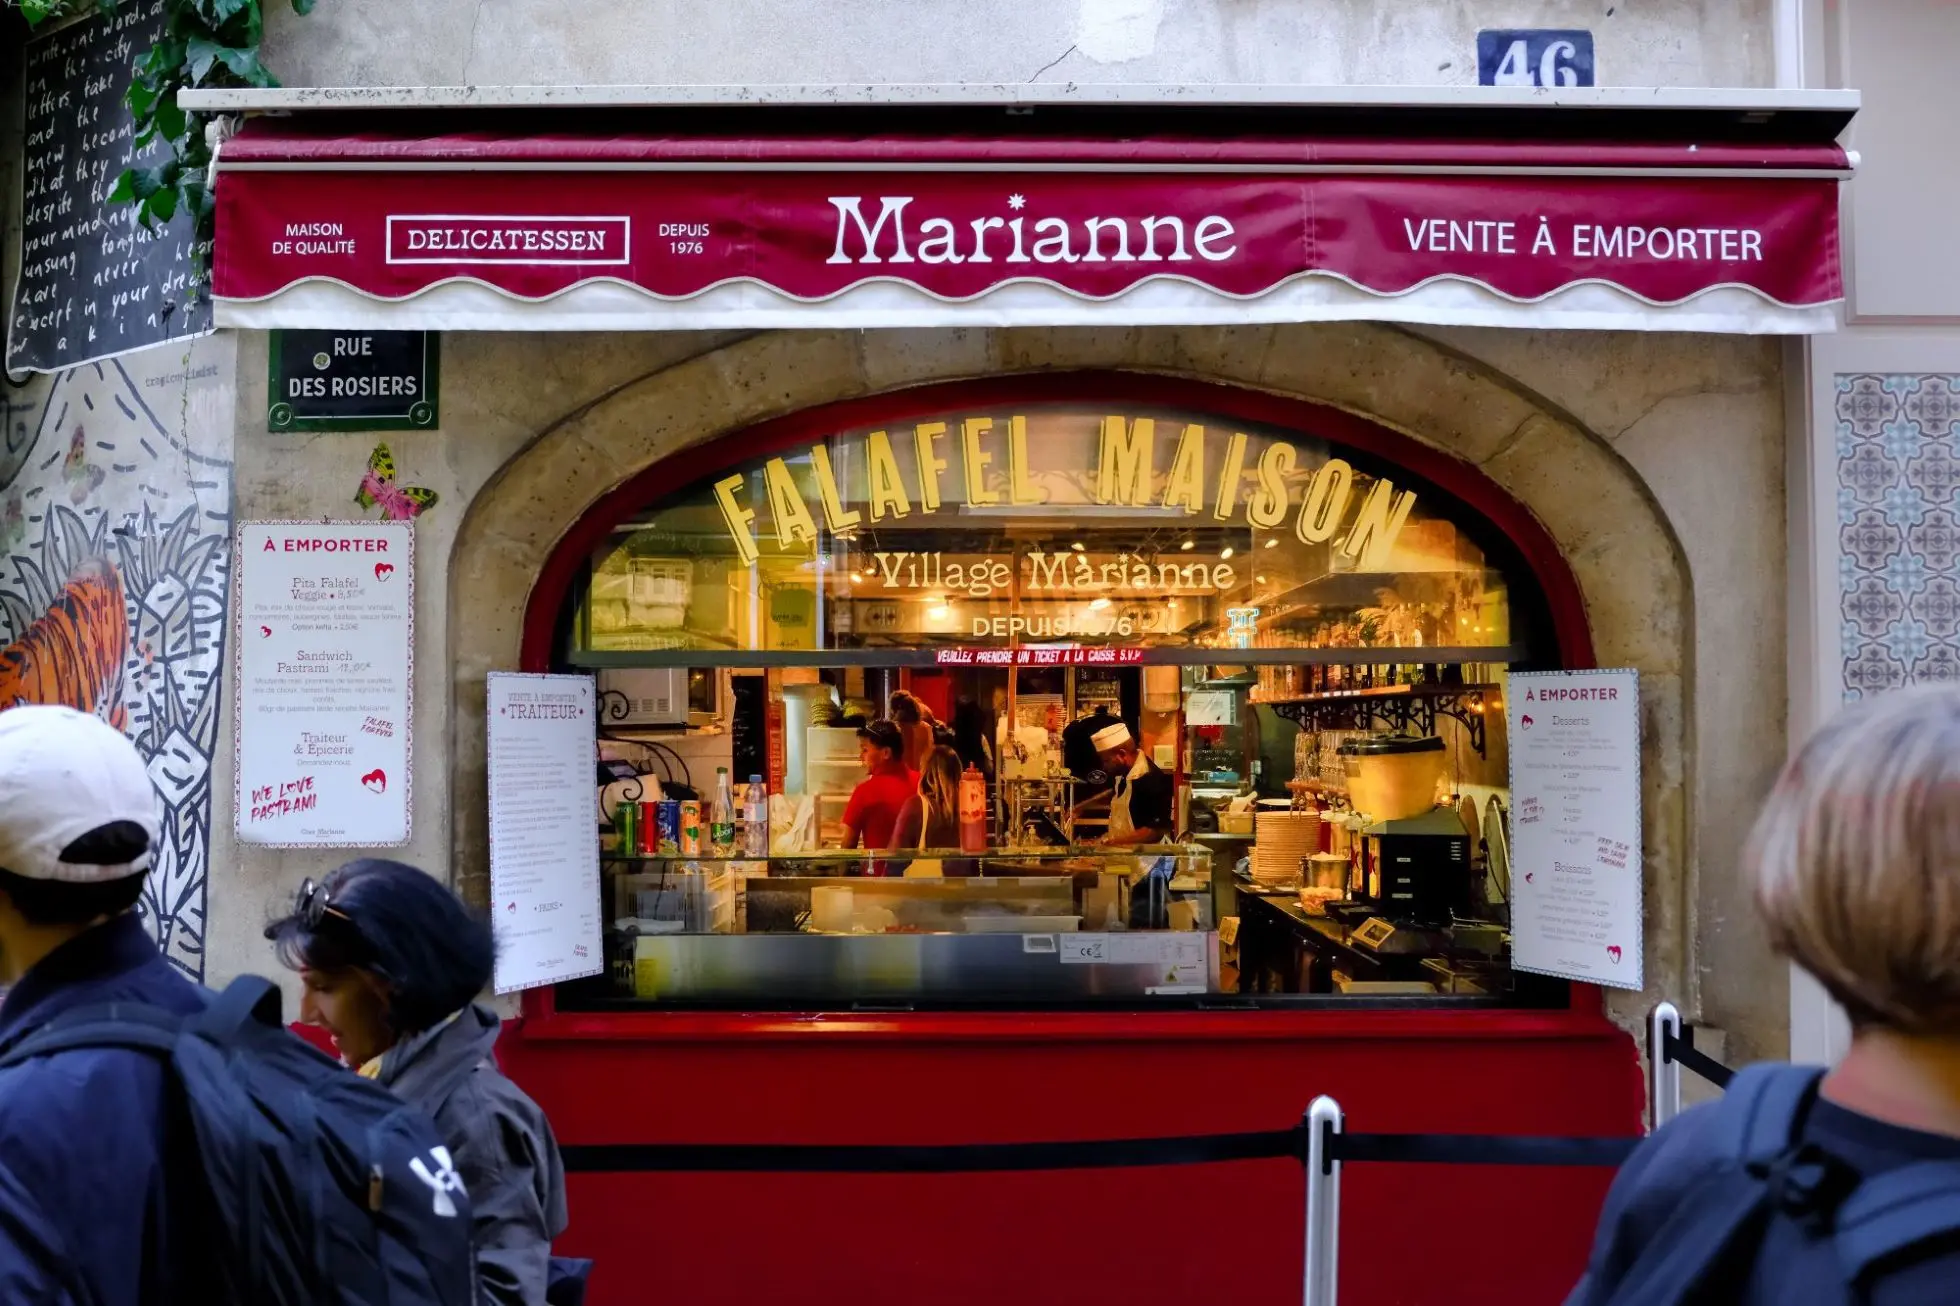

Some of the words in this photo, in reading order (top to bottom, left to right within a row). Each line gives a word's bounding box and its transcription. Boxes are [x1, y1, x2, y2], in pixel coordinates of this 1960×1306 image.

[1493, 40, 1577, 87] 46
[27, 118, 55, 146] and
[77, 105, 99, 128] the
[76, 158, 109, 184] they
[25, 190, 73, 227] despite
[25, 233, 56, 260] your
[62, 207, 101, 242] mind
[285, 222, 343, 238] MAISON
[658, 222, 710, 238] DEPUIS
[825, 192, 1237, 265] Marianne
[1403, 217, 1516, 255] VENTE
[1532, 215, 1557, 256] À
[1573, 225, 1763, 262] EMPORTER
[272, 241, 291, 255] DE
[295, 238, 356, 257] QUALITÉ
[407, 228, 607, 252] DELICATESSEN
[669, 241, 703, 255] 1976
[24, 251, 76, 279] unsung
[93, 258, 140, 287] never
[84, 297, 97, 316] in
[112, 284, 150, 317] your
[333, 336, 373, 357] RUE
[288, 377, 326, 398] DES
[330, 375, 418, 397] ROSIERS
[712, 414, 1050, 569] FALAFEL
[1099, 415, 1418, 572] MAISON
[263, 535, 276, 552] À
[284, 539, 389, 552] EMPORTER
[293, 577, 317, 589] Pita
[320, 576, 359, 589] Falafel
[873, 550, 1012, 597] Village
[1028, 550, 1236, 590] Marianne
[291, 589, 328, 602] Veggie
[972, 616, 1069, 638] DEPUIS
[296, 650, 353, 661] Sandwich
[976, 649, 1013, 663] PRENDRE
[1017, 649, 1030, 663] UN
[1034, 649, 1060, 663] TICKET
[1074, 649, 1084, 662] LA
[1087, 649, 1116, 662] CAISSE
[277, 662, 330, 674] Pastrami
[1526, 686, 1535, 701] À
[1539, 687, 1618, 701] EMPORTER
[508, 704, 578, 720] TRAITEUR
[1552, 715, 1590, 726] Desserts
[301, 732, 348, 743] Traiteur
[293, 744, 304, 754] &
[251, 786, 274, 804] WE
[250, 793, 318, 824] PASTRAMI
